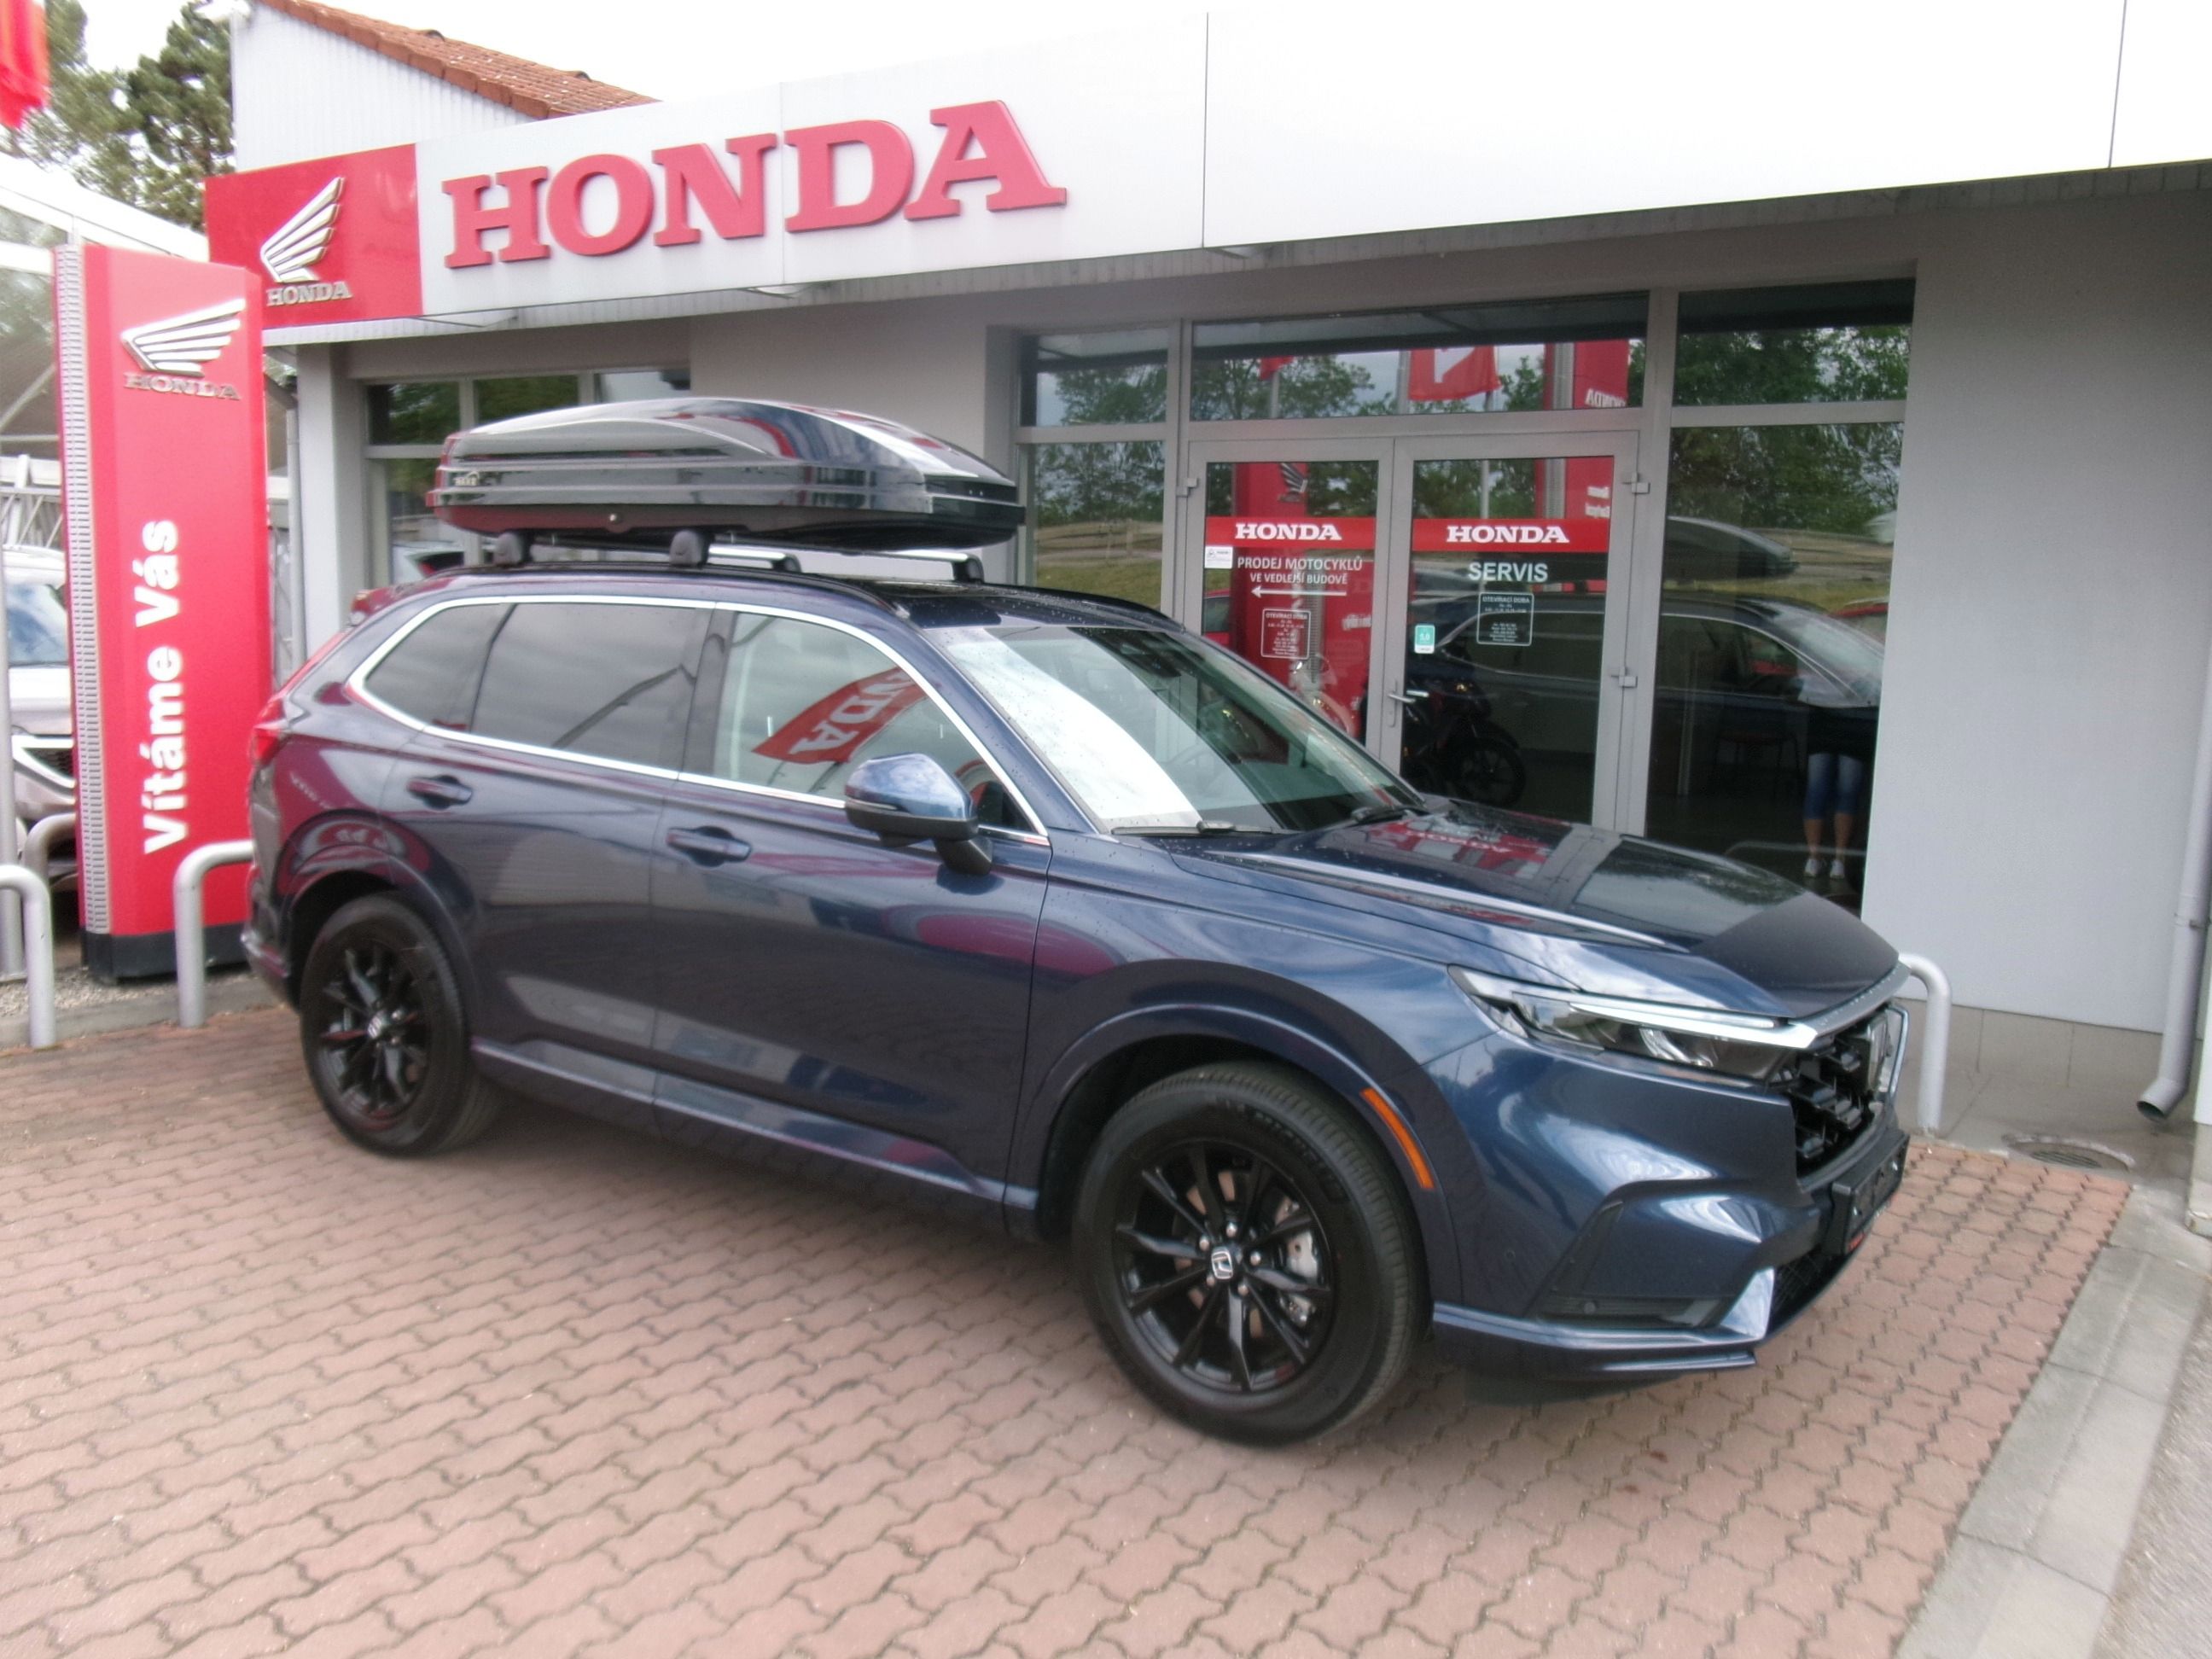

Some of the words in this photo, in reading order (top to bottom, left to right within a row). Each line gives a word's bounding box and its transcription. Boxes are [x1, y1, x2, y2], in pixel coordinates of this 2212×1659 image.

[442, 99, 1067, 269] HONDA
[266, 281, 352, 306] HONDA
[124, 373, 242, 400] HONDA
[1235, 522, 1342, 541] HONDA
[1447, 526, 1570, 544] HONDA
[132, 520, 181, 628] Vás
[1237, 556, 1282, 569] PRODEJ
[1285, 556, 1363, 571] MOTOCYKLŮ
[1468, 562, 1548, 583] SERVIS
[1250, 573, 1261, 583] VE
[1264, 571, 1305, 584] VEDLEJŠÍ
[1307, 573, 1348, 585] BUDOVĚ
[139, 646, 189, 855] Vítáme
